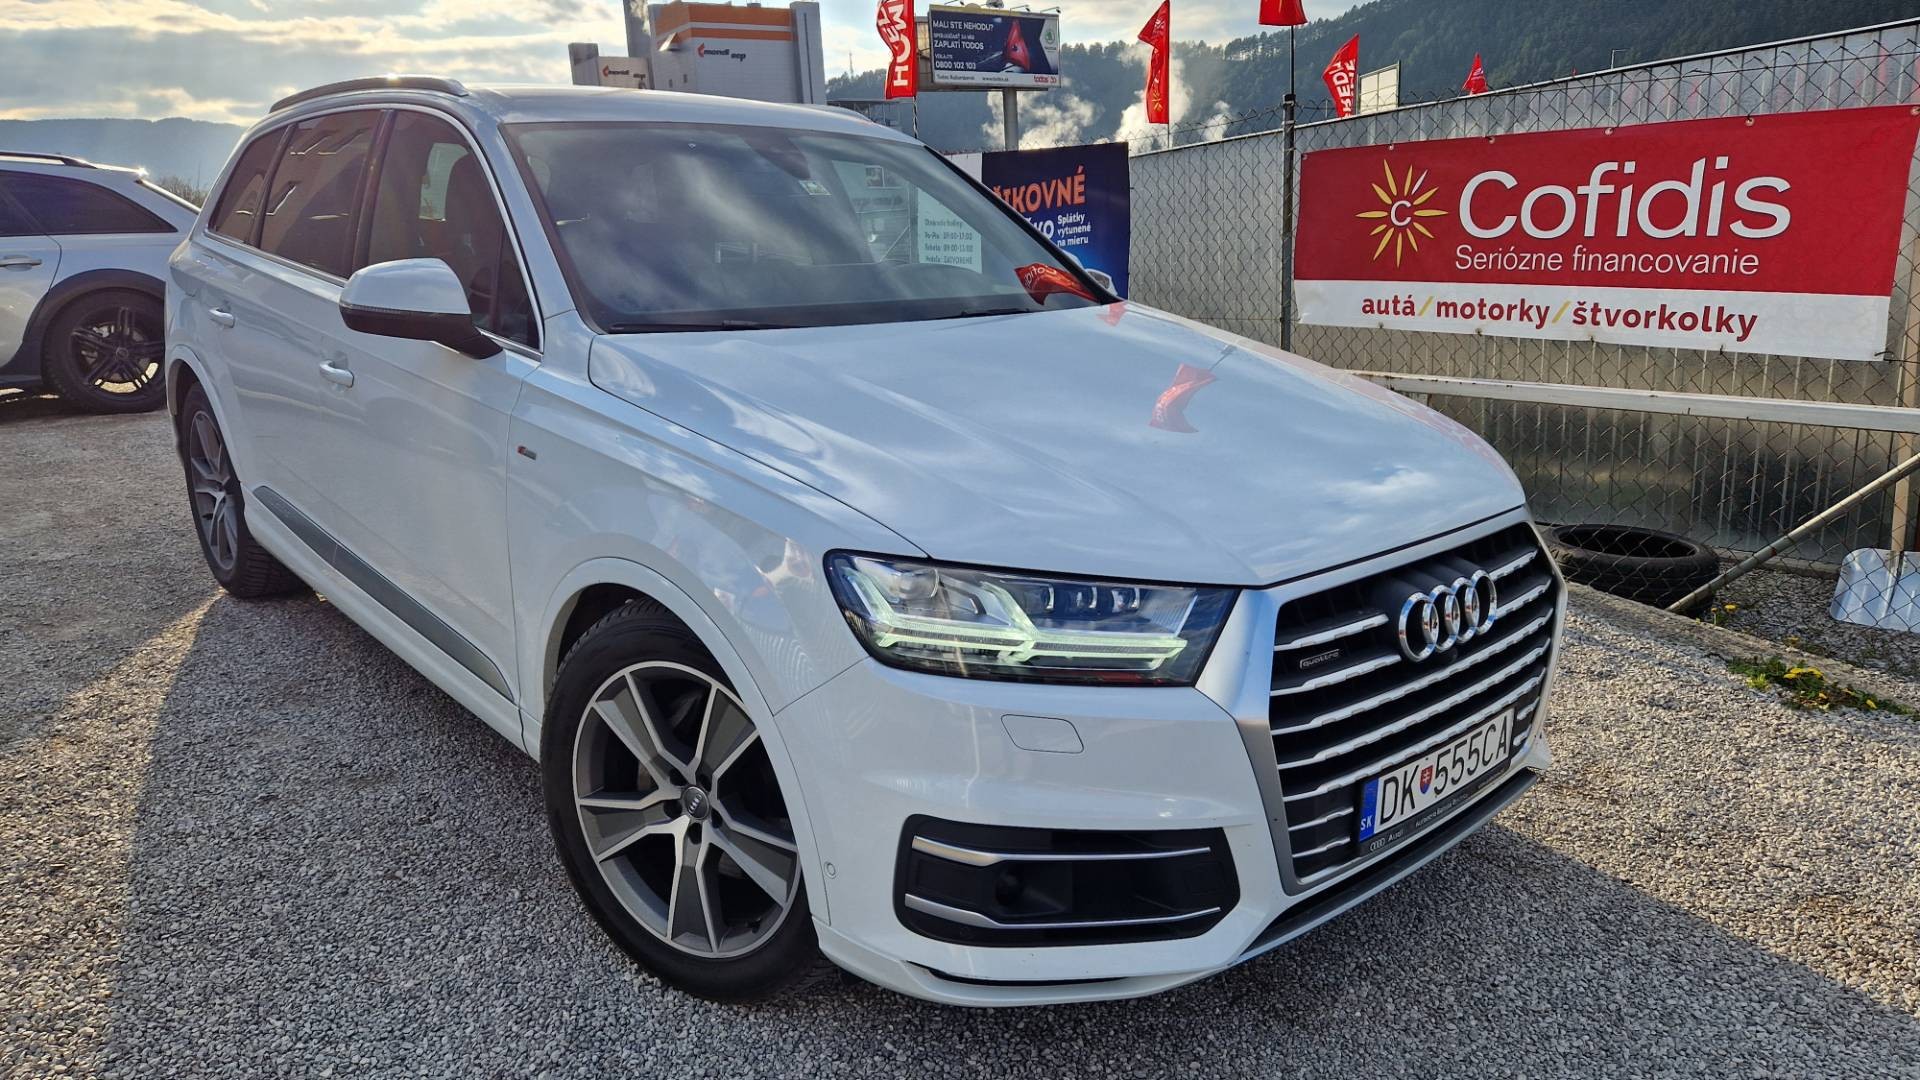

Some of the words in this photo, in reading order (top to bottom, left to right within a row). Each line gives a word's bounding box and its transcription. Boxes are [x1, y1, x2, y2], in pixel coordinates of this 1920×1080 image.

[933, 21, 949, 29] MALI
[950, 21, 962, 30] STE
[964, 22, 994, 31] NEHODU?
[934, 40, 961, 49] ZAPLATÍ
[962, 42, 984, 50] TODOS
[936, 61, 952, 69] 0800
[1459, 156, 1791, 239] Cofidis
[1057, 212, 1085, 226] Splátky
[1057, 222, 1092, 237] vytunené
[1057, 239, 1066, 247] na
[1067, 236, 1089, 246] mieru
[1455, 244, 1563, 271] Seriózne
[1572, 244, 1760, 275] financovanie
[1380, 764, 1420, 825] DK
[1434, 715, 1508, 796] 555CA
[1361, 814, 1373, 831] SK
